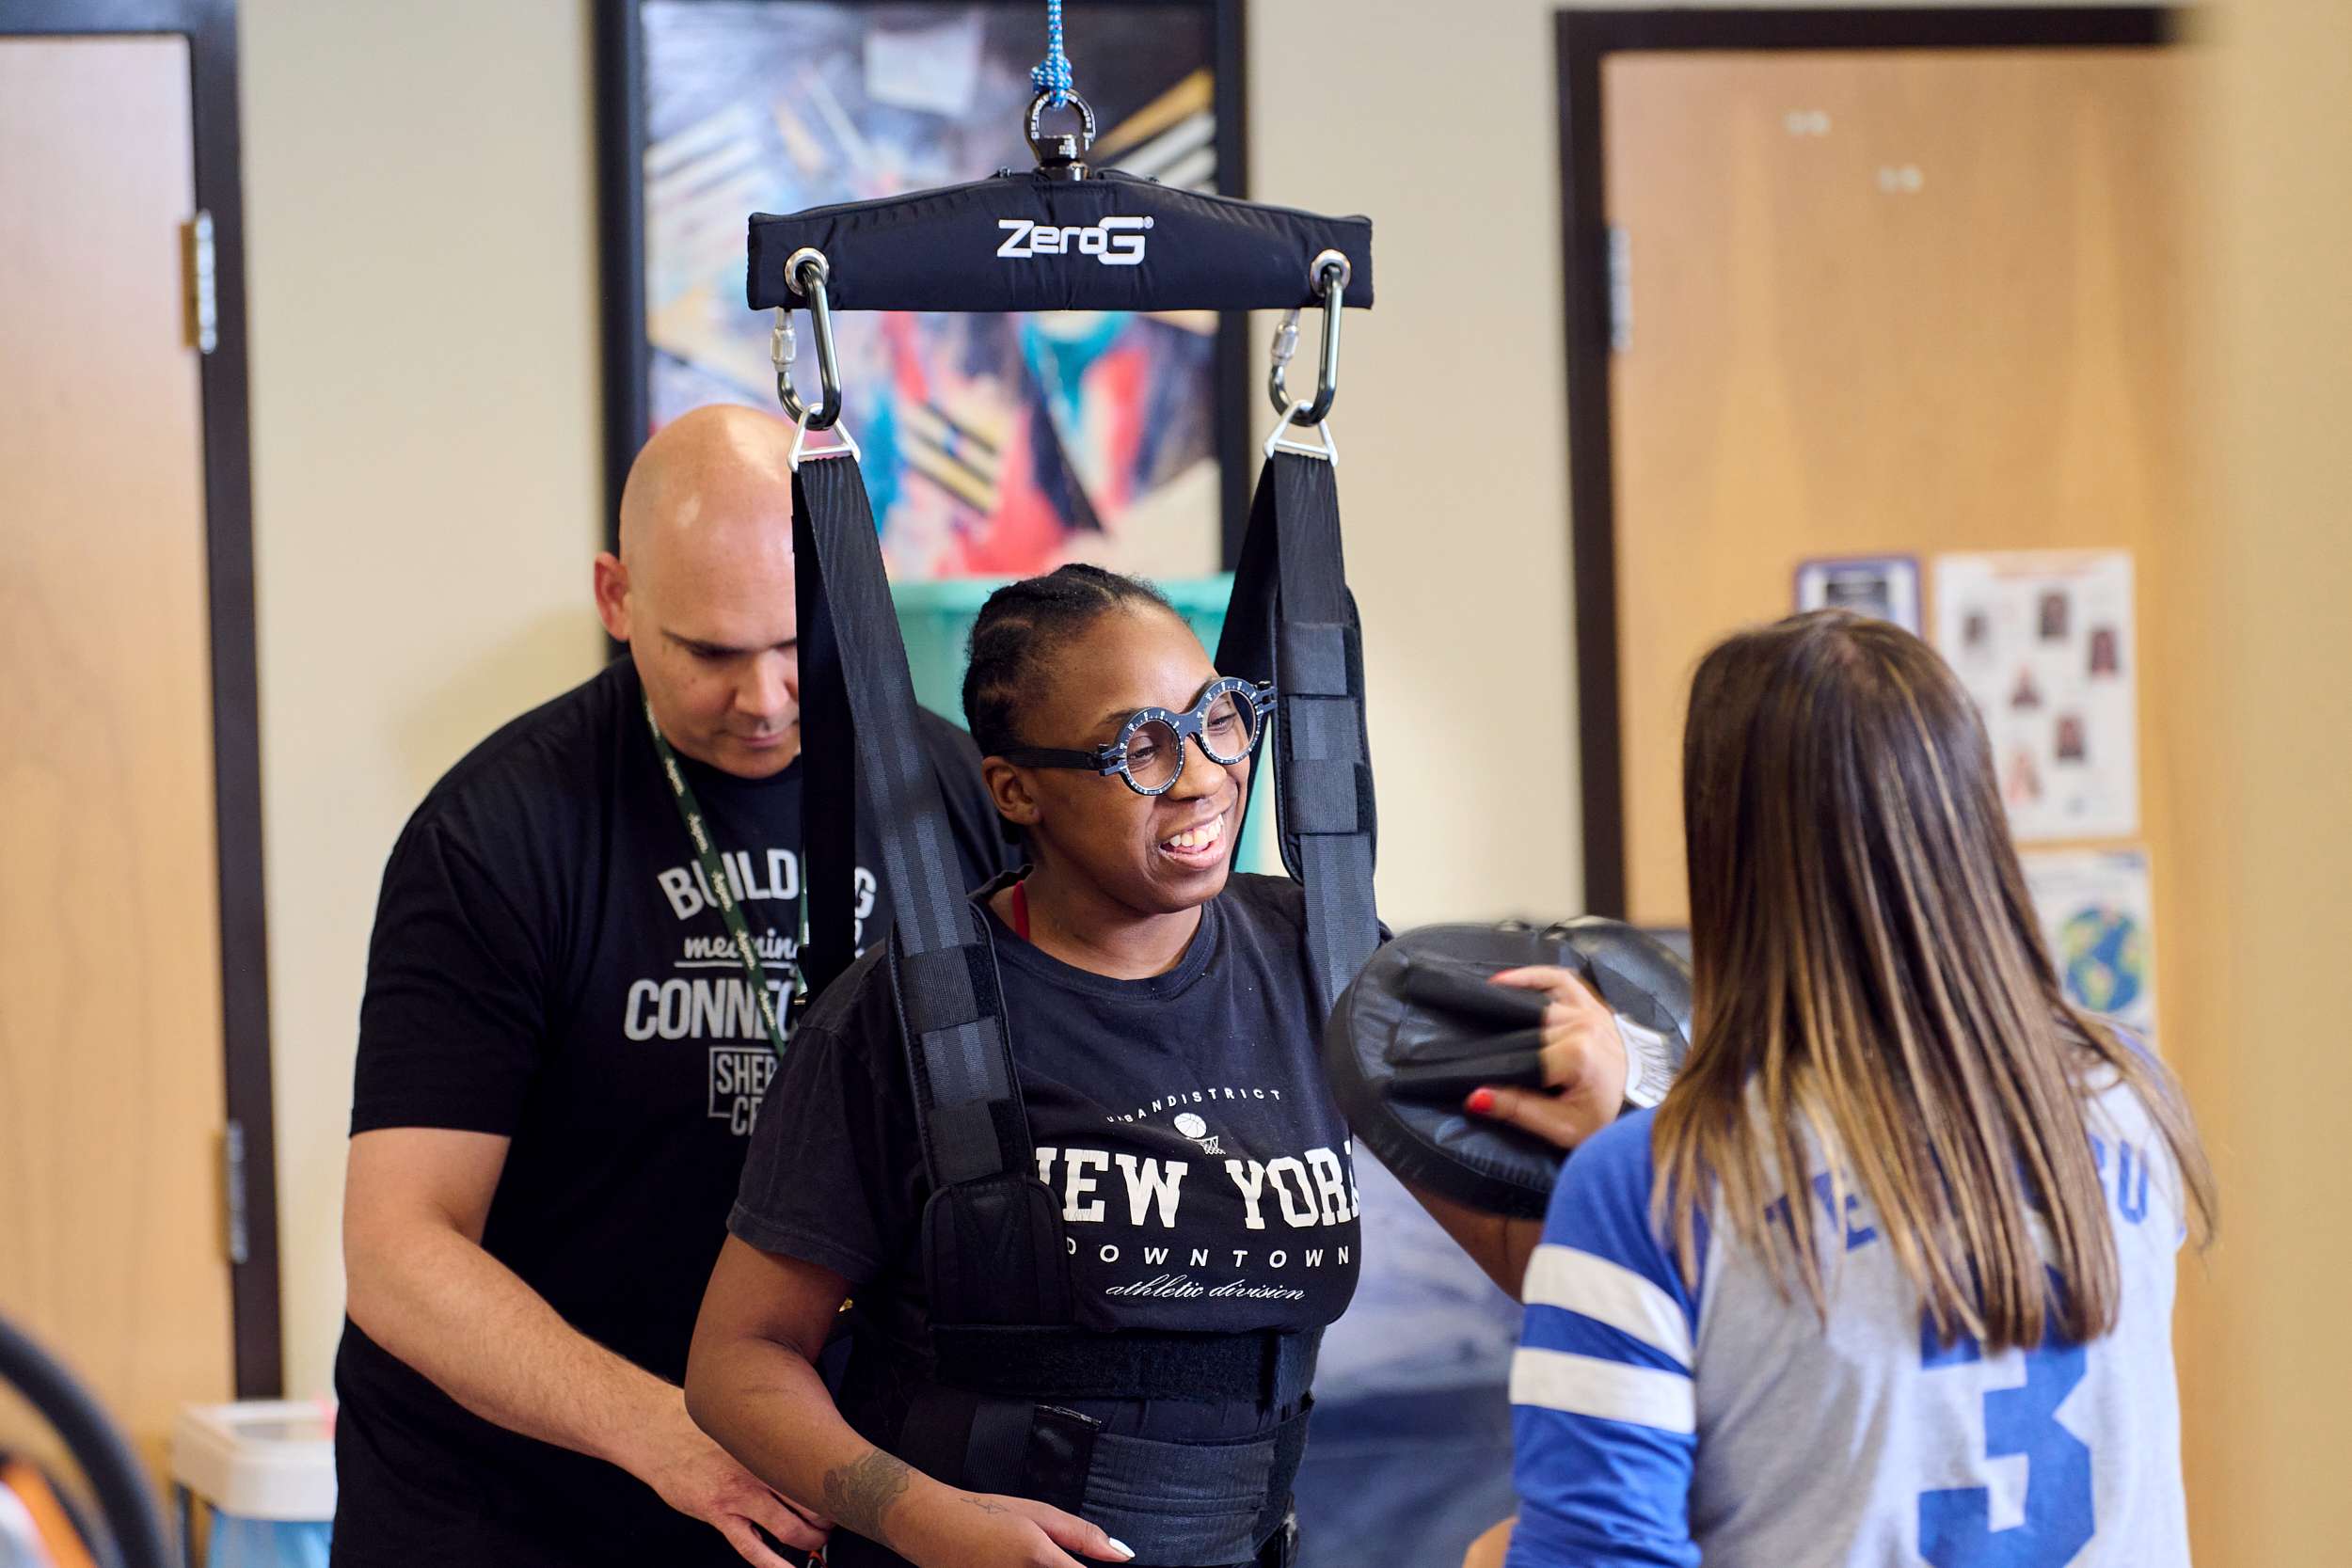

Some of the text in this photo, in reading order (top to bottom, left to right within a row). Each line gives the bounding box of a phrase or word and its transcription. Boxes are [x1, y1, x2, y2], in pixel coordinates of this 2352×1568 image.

[658, 848, 876, 920] BUILDG
[1225, 1140, 1359, 1229] YOR
[1066, 1236, 1349, 1268] DOWNTOWN
[1105, 1274, 1305, 1300] athletic division
